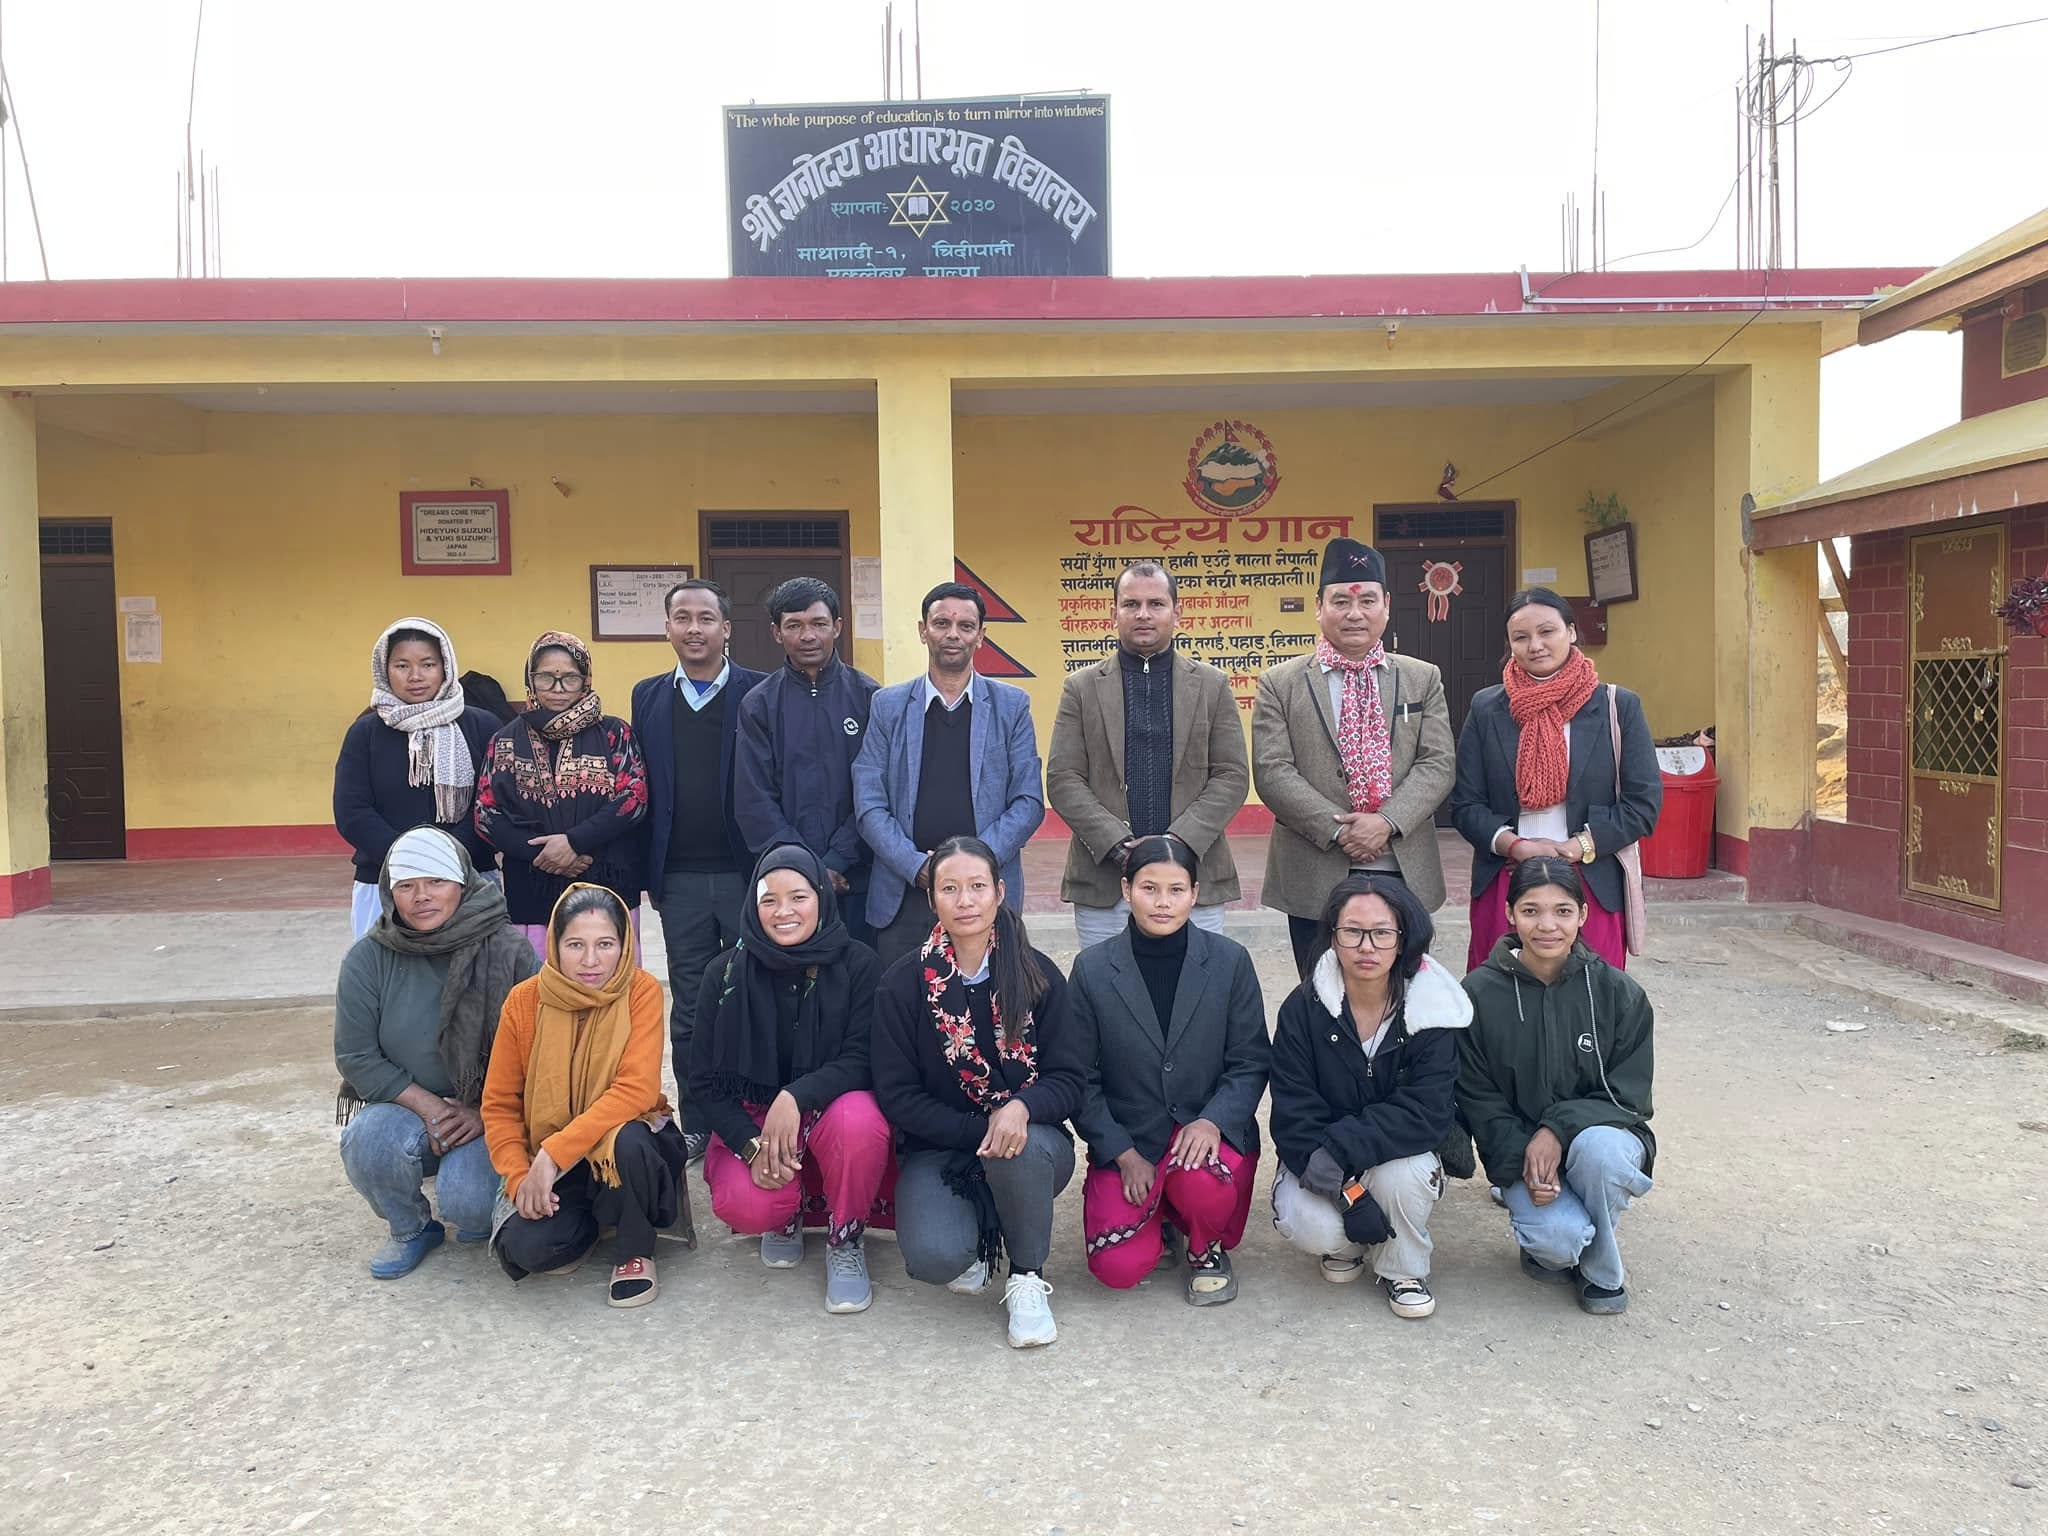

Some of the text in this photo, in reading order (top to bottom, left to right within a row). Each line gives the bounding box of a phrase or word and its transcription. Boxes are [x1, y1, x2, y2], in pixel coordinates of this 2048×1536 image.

[761, 112, 800, 128] whole
[804, 113, 857, 129] purpose
[860, 110, 875, 125] of
[876, 109, 932, 124] education
[935, 109, 944, 122] is
[948, 108, 960, 121] to
[964, 108, 991, 121] turn
[994, 106, 1032, 120] mirror
[1034, 105, 1053, 118] into
[741, 194, 783, 252] श्री
[863, 126, 994, 179] आधारभूत
[992, 135, 1097, 241] विद्यालय
[951, 200, 995, 214] २०३०
[420, 527, 459, 535] HIDEYUKI
[1070, 505, 1232, 550] राष्ट्रिय
[1239, 516, 1353, 542] गान
[1168, 552, 1198, 570] हामी
[1235, 553, 1271, 568] माला
[1276, 548, 1318, 567] नेपाली
[1205, 570, 1237, 589] मेची
[1058, 595, 1106, 615] प्रकृतिका
[1215, 590, 1249, 609] आँचल
[1270, 629, 1316, 648] हिमाल
